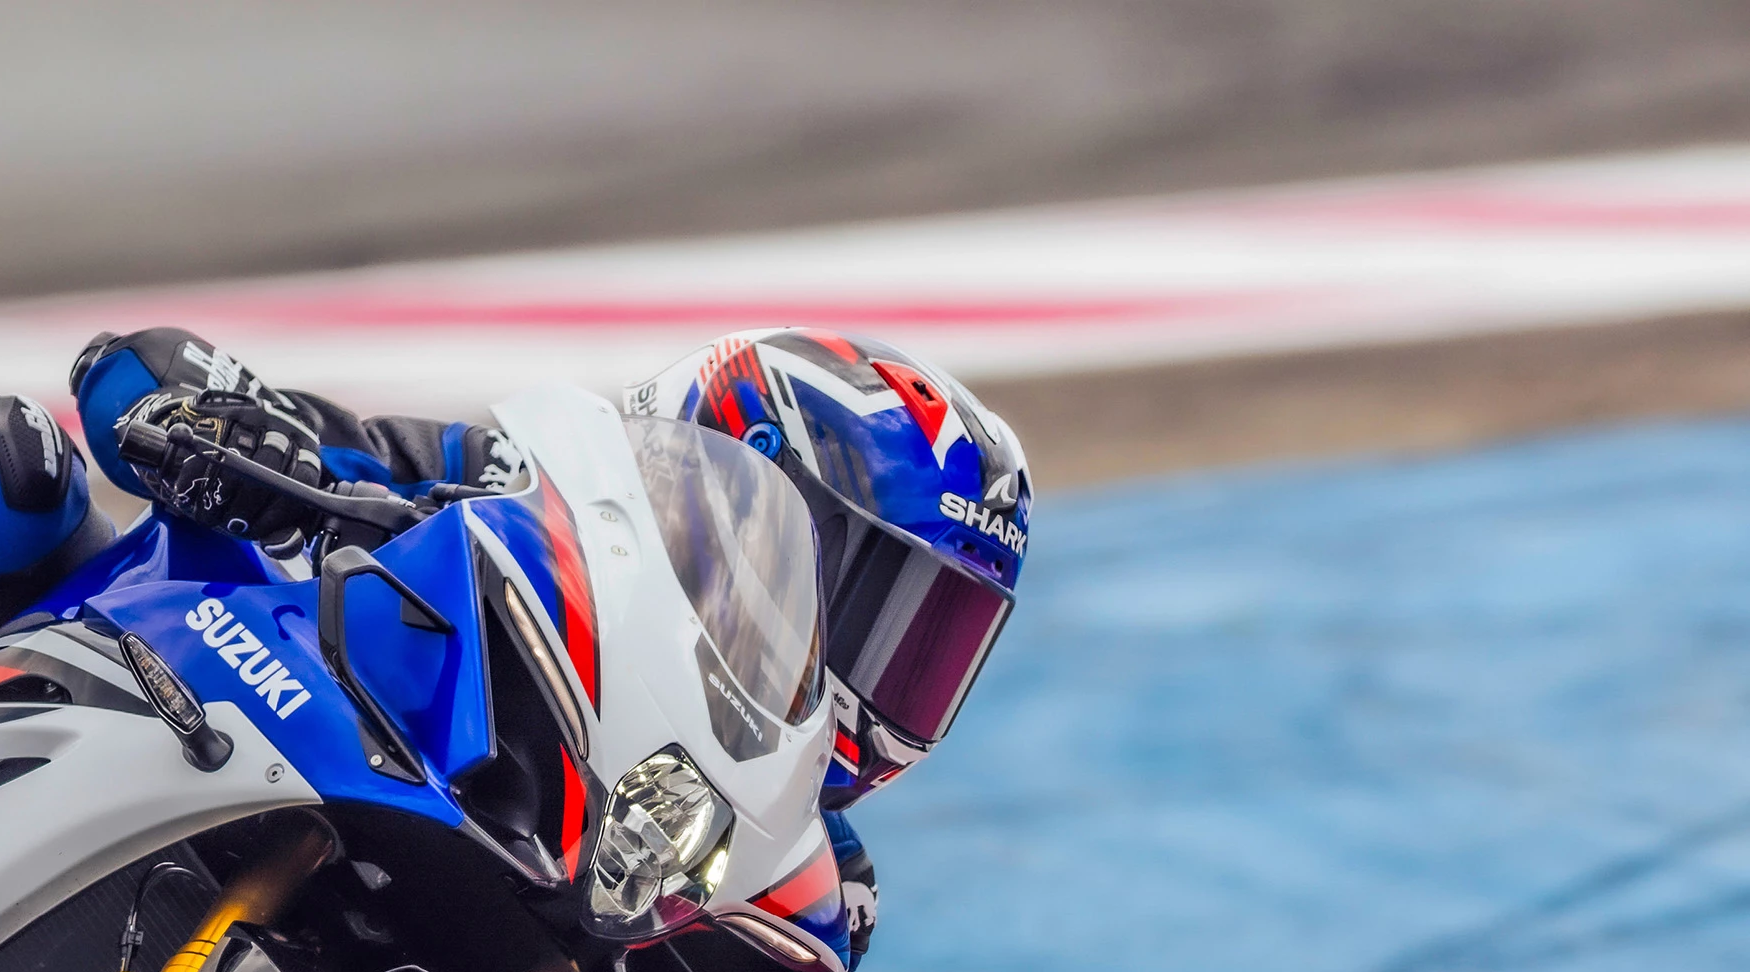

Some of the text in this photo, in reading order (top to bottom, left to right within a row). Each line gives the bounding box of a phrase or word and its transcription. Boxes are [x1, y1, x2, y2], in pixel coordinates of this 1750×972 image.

[939, 492, 1027, 558] SHARK
[185, 598, 312, 720] SUZUKI
[708, 672, 763, 742] SUZUKI
